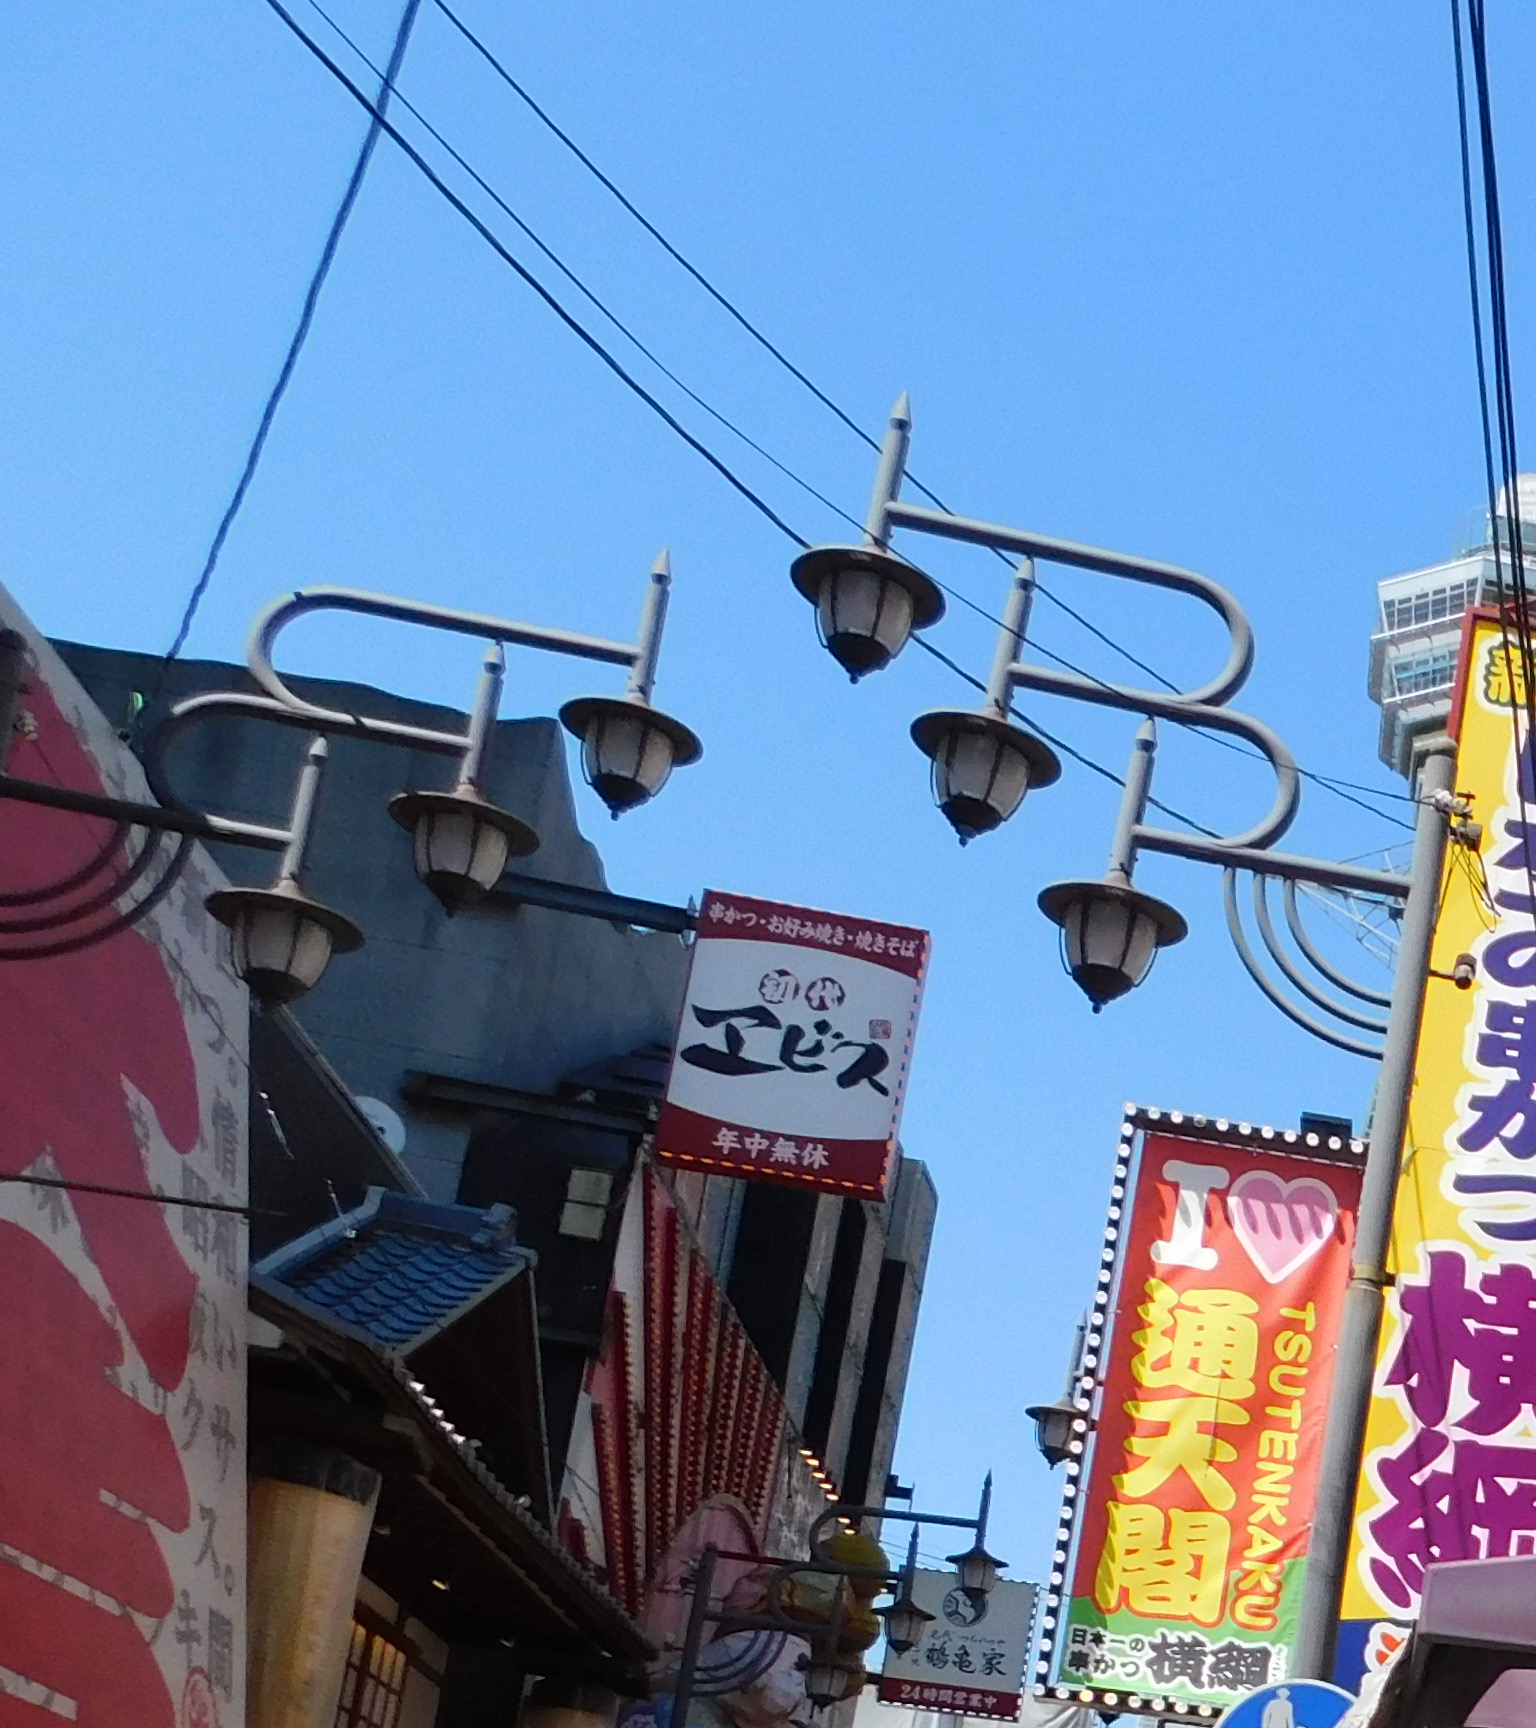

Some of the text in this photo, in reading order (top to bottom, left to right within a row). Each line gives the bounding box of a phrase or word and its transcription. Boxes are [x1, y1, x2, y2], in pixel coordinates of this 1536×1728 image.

[712, 1127, 830, 1169] 年中無休
[1096, 1276, 1260, 1622] 通天閣
[1229, 1302, 1317, 1630] TSUTENKAKU
[1067, 1649, 1141, 1676] 串かつ
[1070, 1628, 1146, 1652] 日本一の
[1147, 1632, 1273, 1691] 横綱
